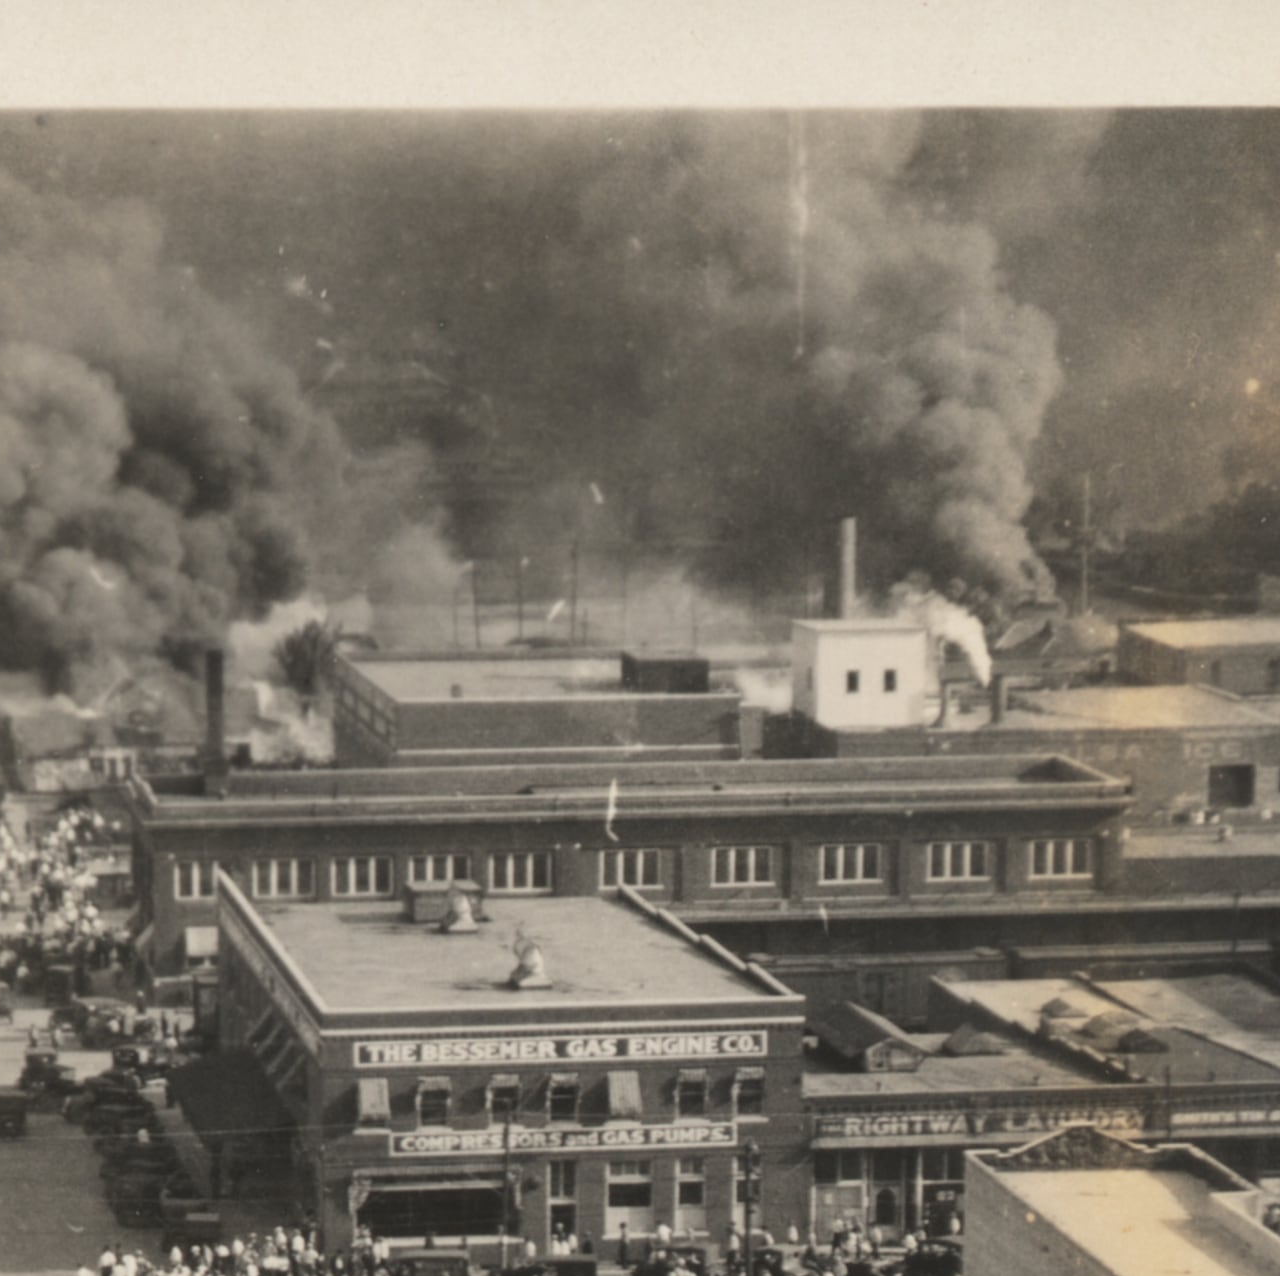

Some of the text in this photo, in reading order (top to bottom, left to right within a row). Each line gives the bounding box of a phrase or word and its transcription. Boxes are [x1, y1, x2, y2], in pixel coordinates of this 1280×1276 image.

[1183, 741, 1243, 759] ICE
[366, 1034, 760, 1063] THE BESSEMER GAS ENGINE CO.
[401, 1126, 730, 1150] COMPRESSORS and GAS PUMPS.
